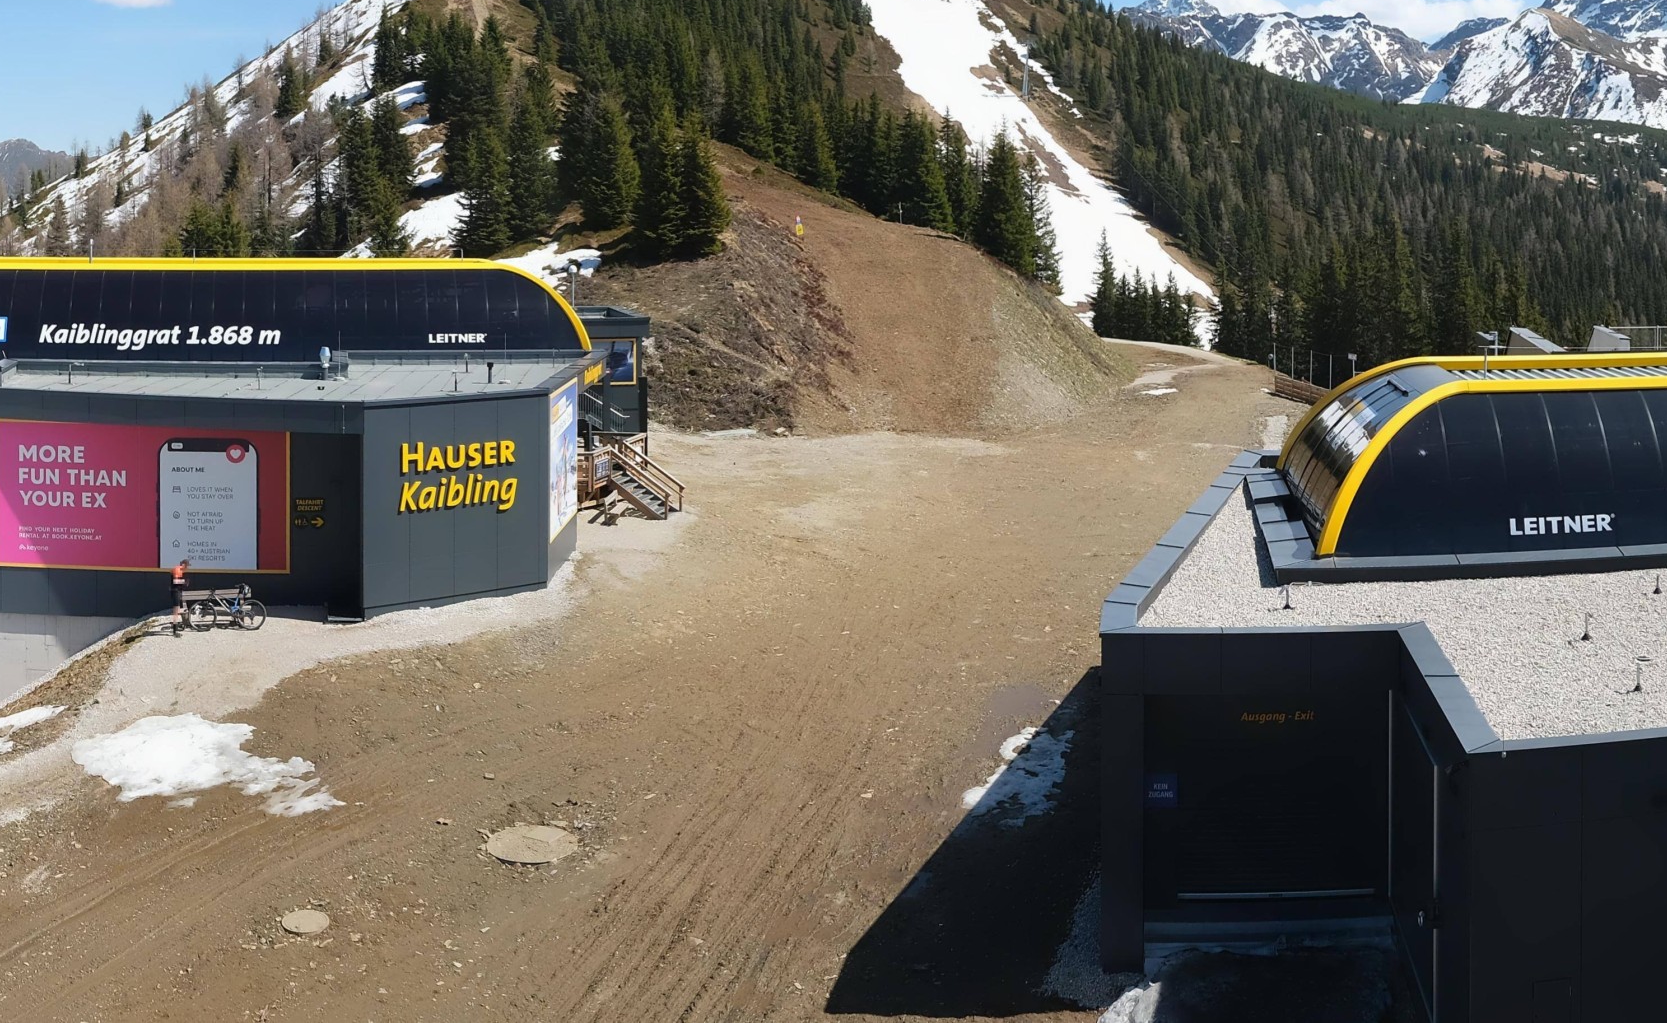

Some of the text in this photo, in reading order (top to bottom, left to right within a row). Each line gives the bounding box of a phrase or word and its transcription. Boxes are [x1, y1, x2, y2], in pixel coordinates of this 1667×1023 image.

[38, 323, 281, 350] Kaiblinggrat 1.868 m
[428, 333, 486, 344] LEITNER
[18, 444, 85, 464] MORE
[401, 440, 516, 474] HAUSER
[18, 467, 127, 487] FUN THAN
[20, 490, 107, 508] YOUR EX
[399, 473, 518, 513] Kaibling
[1509, 514, 1613, 536] LEITNER
[1240, 711, 1286, 723] Ausgang
[1294, 710, 1315, 721] Exit
